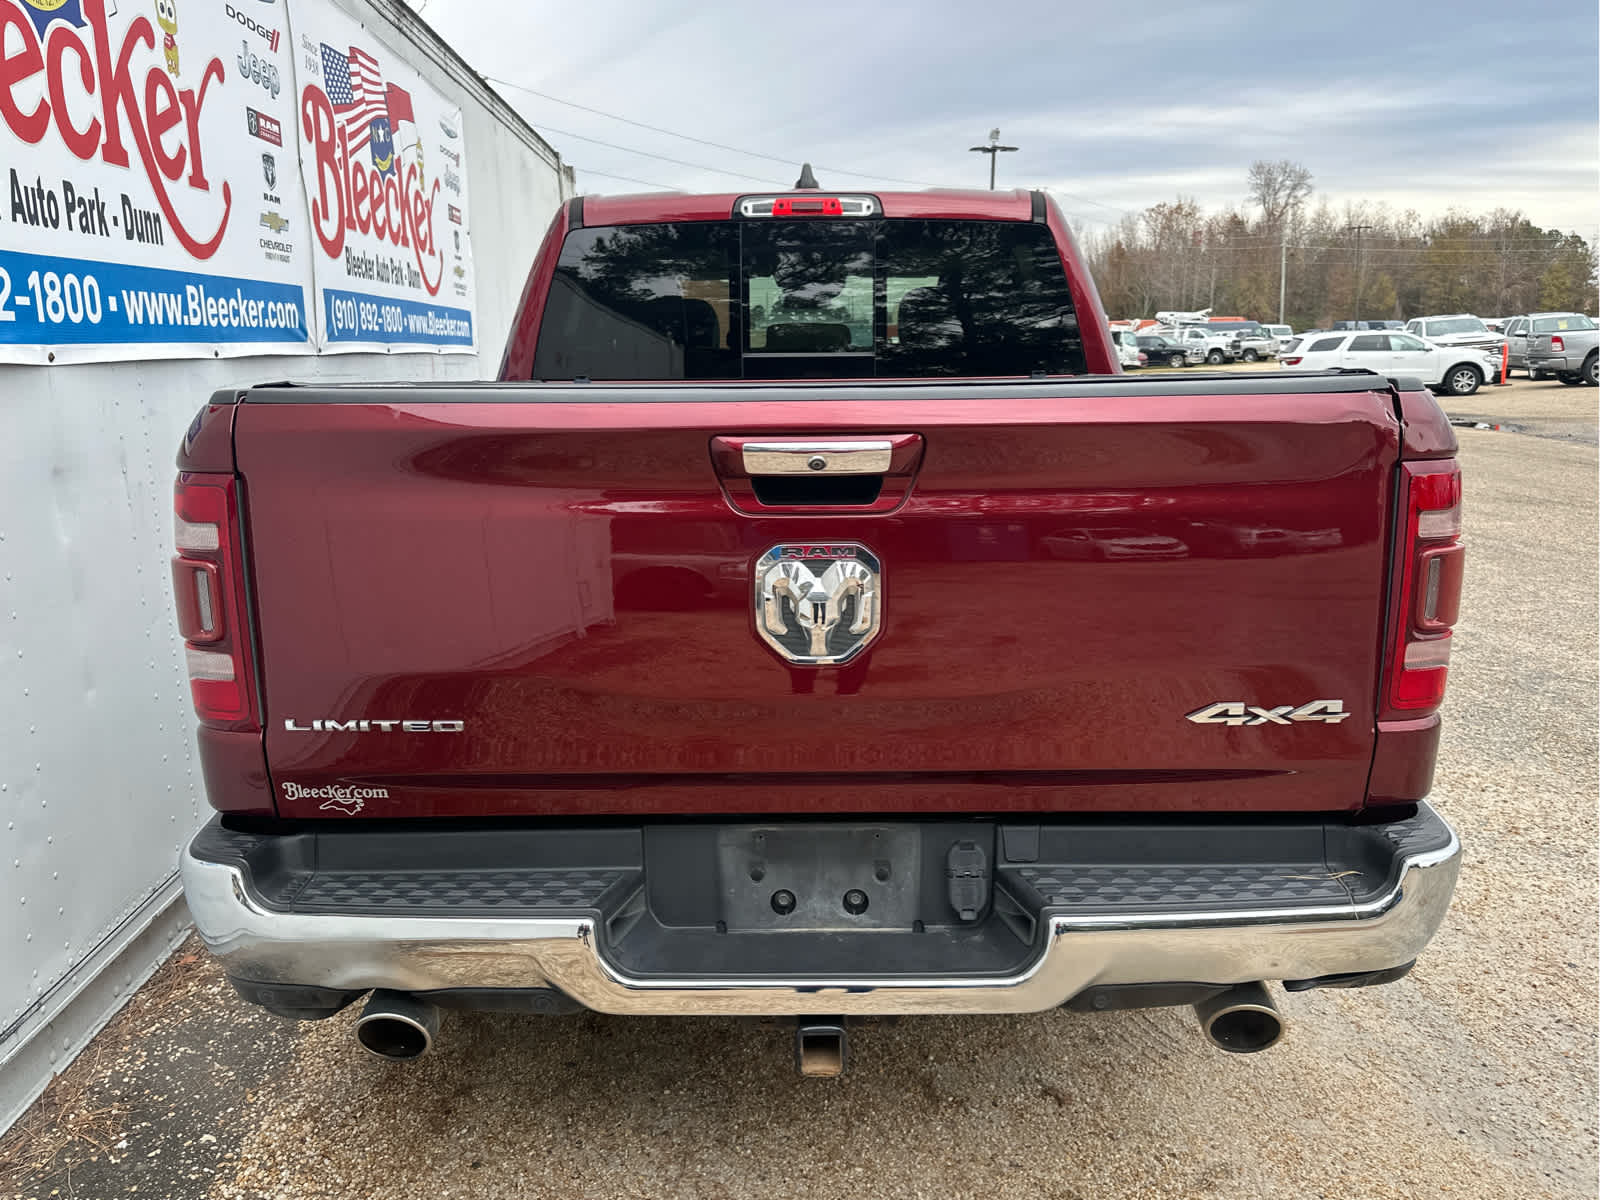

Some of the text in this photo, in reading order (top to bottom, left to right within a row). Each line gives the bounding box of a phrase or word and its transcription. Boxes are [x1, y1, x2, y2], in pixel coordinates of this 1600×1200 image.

[225, 3, 273, 42] DODGE
[301, 33, 318, 56] Since
[237, 39, 280, 99] Jeep
[259, 118, 280, 134] RAM
[10, 168, 164, 246] Auto Park Dunn
[263, 193, 281, 204] RAM
[302, 83, 443, 297] Bleecker
[260, 238, 293, 253] CHEVROLET
[345, 245, 421, 289] Bleecker Auto Park Dunn
[121, 284, 299, 330] www.Bleecker.com
[331, 295, 471, 337] (910) 892-1800 www.Bleecker.com
[780, 545, 857, 558] RAM
[284, 718, 465, 733] LIMITED
